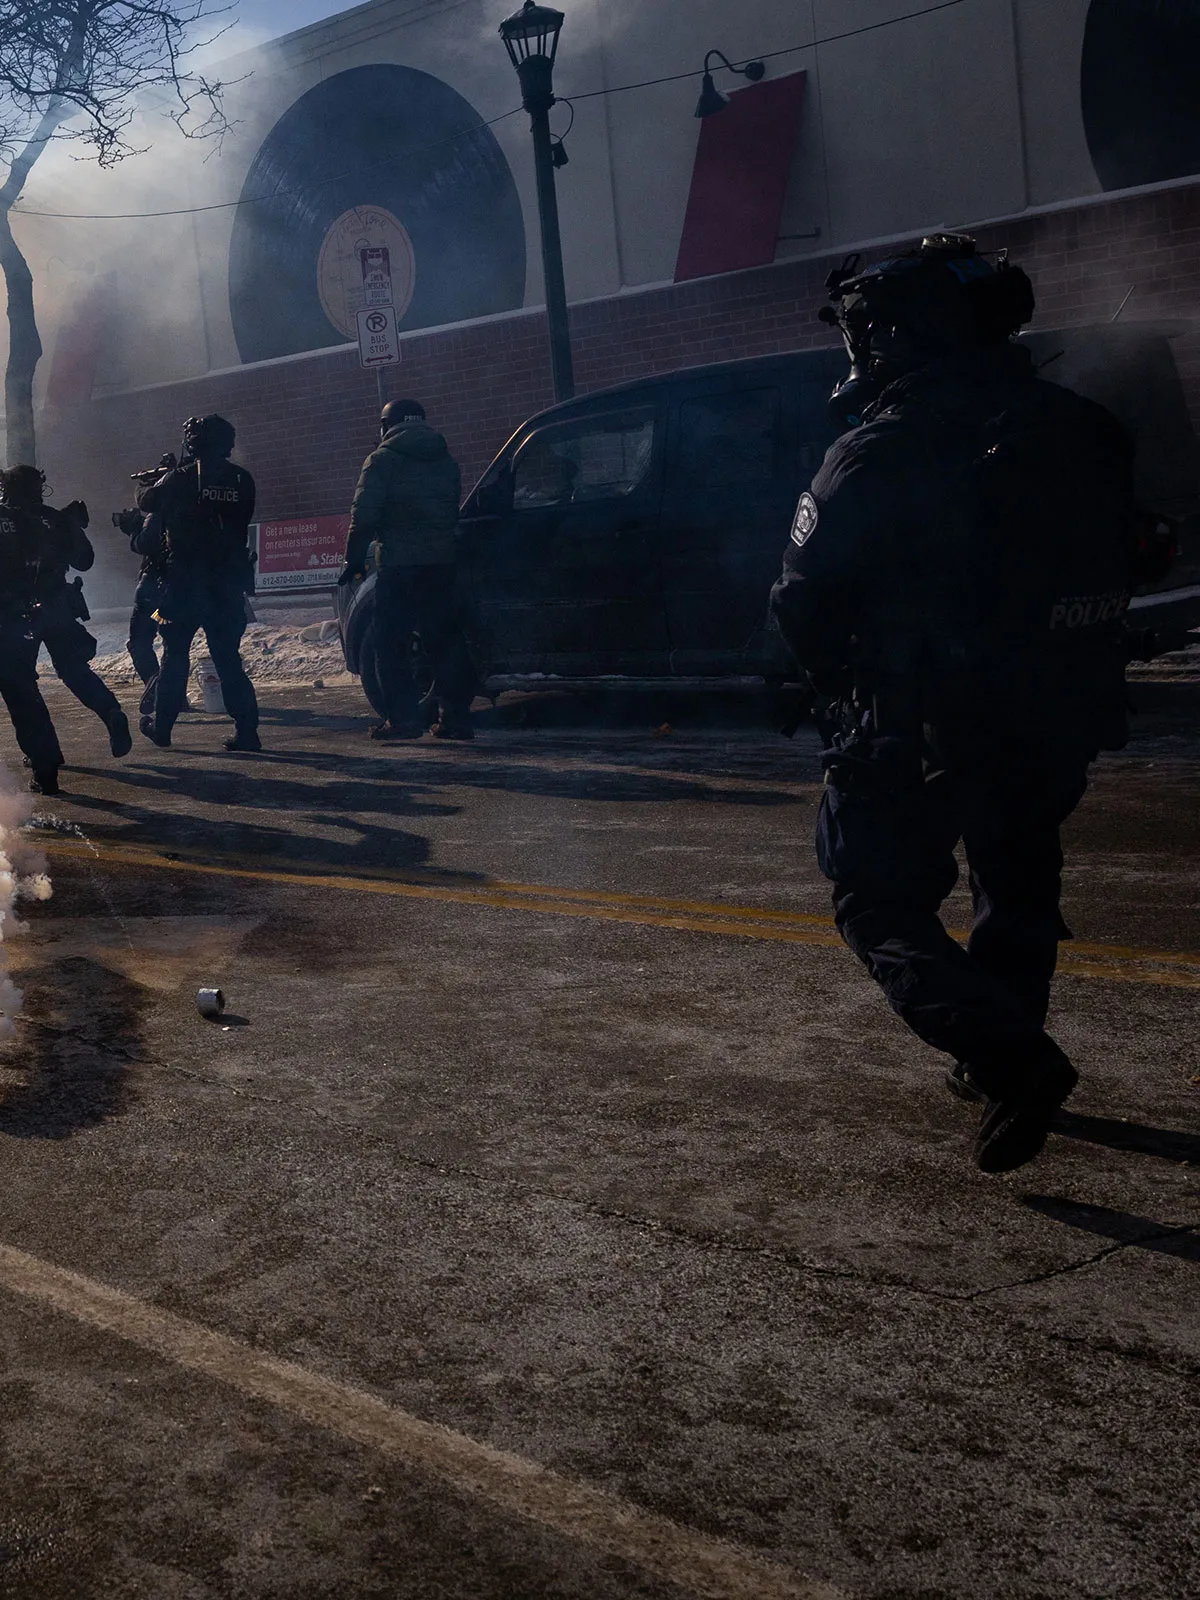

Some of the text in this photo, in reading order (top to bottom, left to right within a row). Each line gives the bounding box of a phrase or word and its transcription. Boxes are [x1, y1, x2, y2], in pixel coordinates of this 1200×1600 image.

[370, 335, 387, 345] BUS
[369, 343, 390, 354] STOP
[202, 488, 239, 503] POLICE
[265, 526, 278, 537] Get
[283, 526, 298, 535] new
[298, 523, 318, 533] lease
[265, 542, 274, 550] on
[274, 539, 300, 550] renters
[320, 551, 343, 565] State
